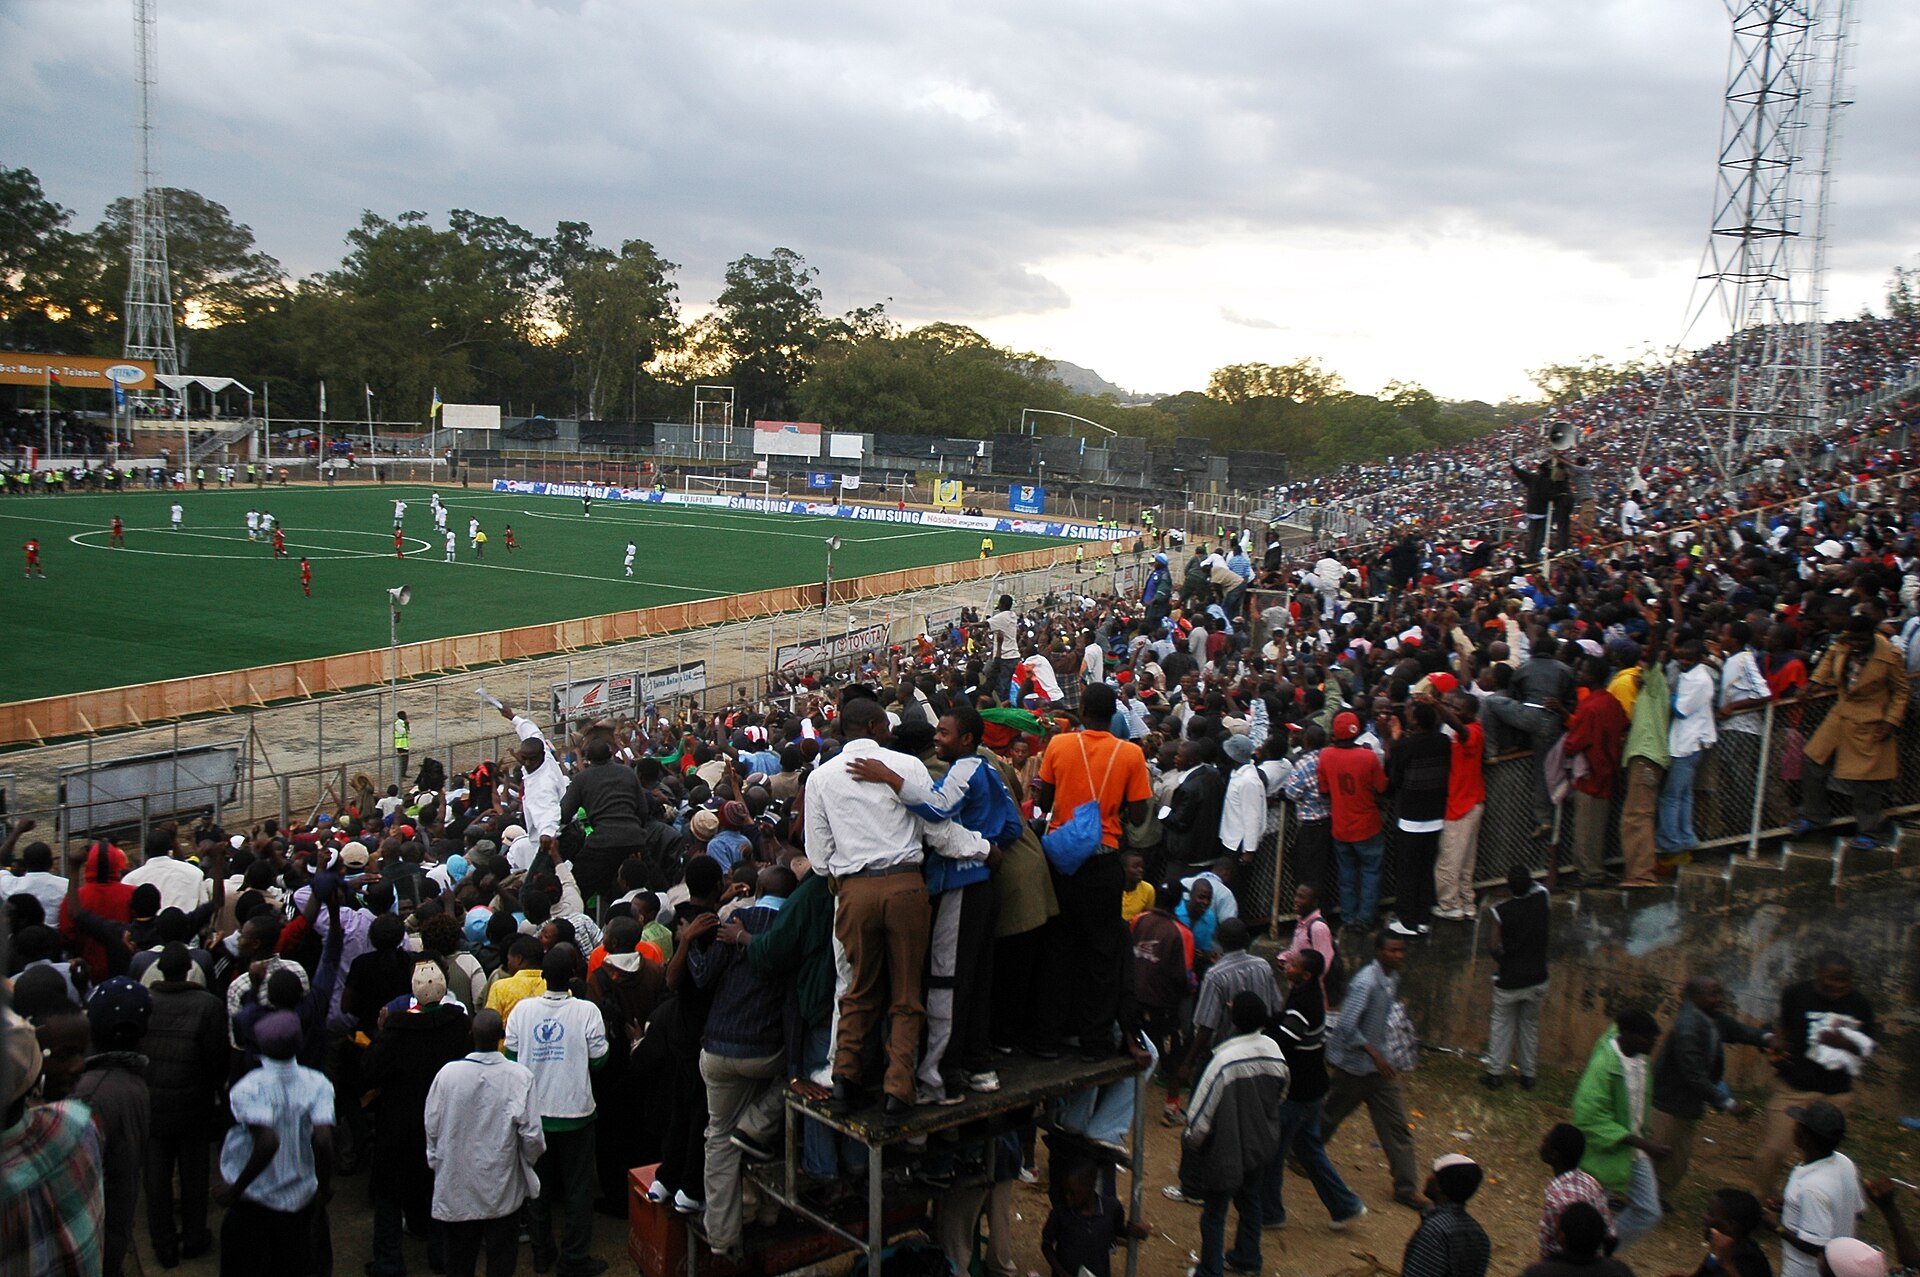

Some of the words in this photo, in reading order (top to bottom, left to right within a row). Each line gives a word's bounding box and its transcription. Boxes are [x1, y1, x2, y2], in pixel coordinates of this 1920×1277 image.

[551, 484, 604, 499] SAMSUNG
[680, 495, 713, 504] FUJIFILM
[730, 497, 787, 513] SAMSUNG
[859, 507, 920, 524] SAMSUNG
[958, 520, 989, 528] express
[848, 629, 881, 648] TOYOTA
[1338, 773, 1356, 796] 10
